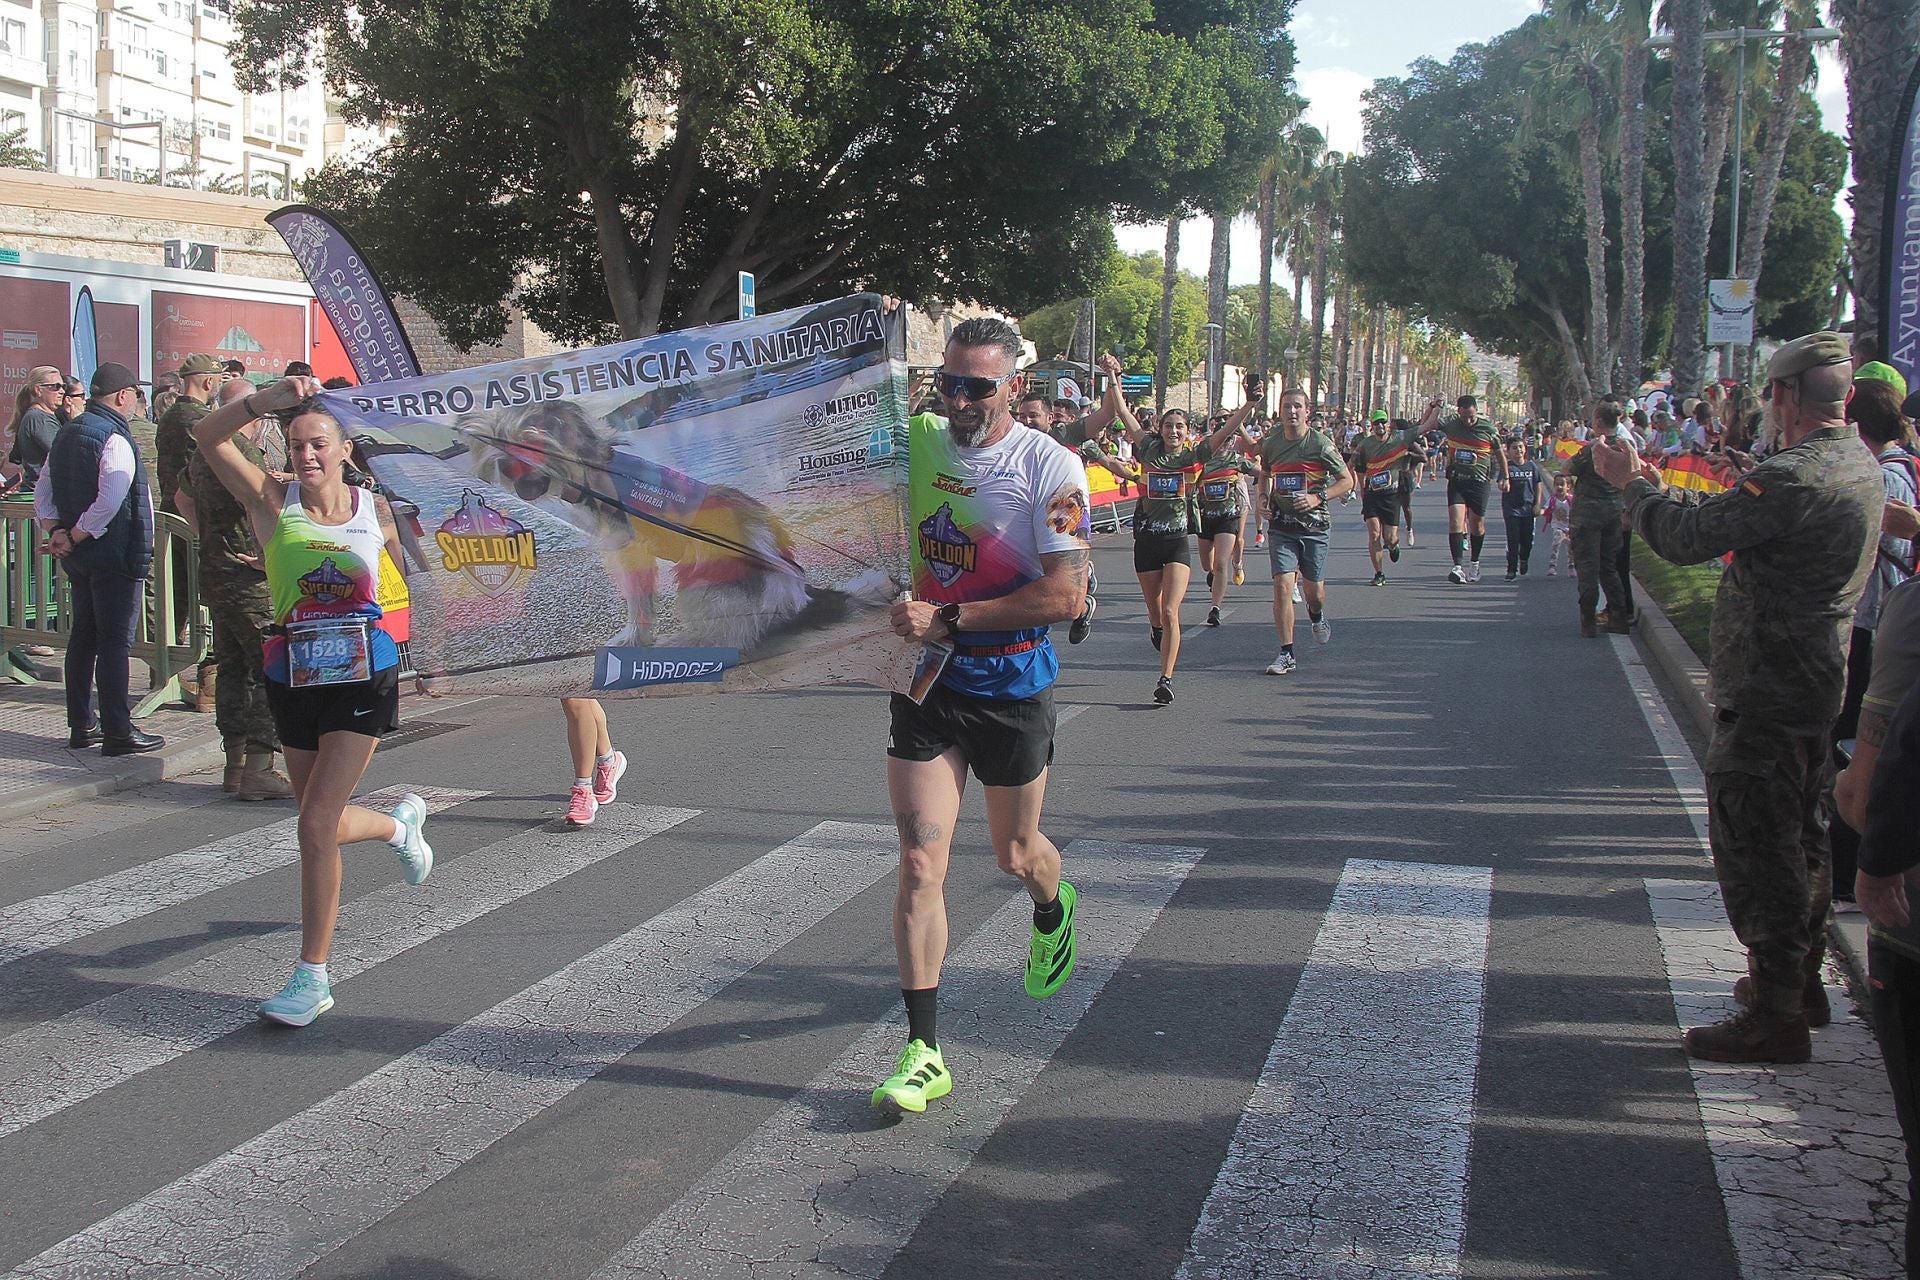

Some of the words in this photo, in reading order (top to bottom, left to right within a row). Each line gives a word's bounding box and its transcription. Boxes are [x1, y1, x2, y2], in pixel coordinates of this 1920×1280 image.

[485, 348, 698, 410] ASISTENCIA
[704, 309, 885, 374] SANITARIA
[3, 363, 28, 378] bus
[798, 448, 867, 471] Housing
[1156, 478, 1172, 487] 137
[1209, 485, 1222, 493] 375
[1282, 477, 1296, 486] 165
[437, 531, 534, 570] SHELDON
[474, 565, 508, 577] RUNNING
[481, 574, 503, 585] CLUB
[298, 579, 356, 599] SHELDON
[301, 639, 347, 659] 1528
[1004, 640, 1033, 655] KEEPER
